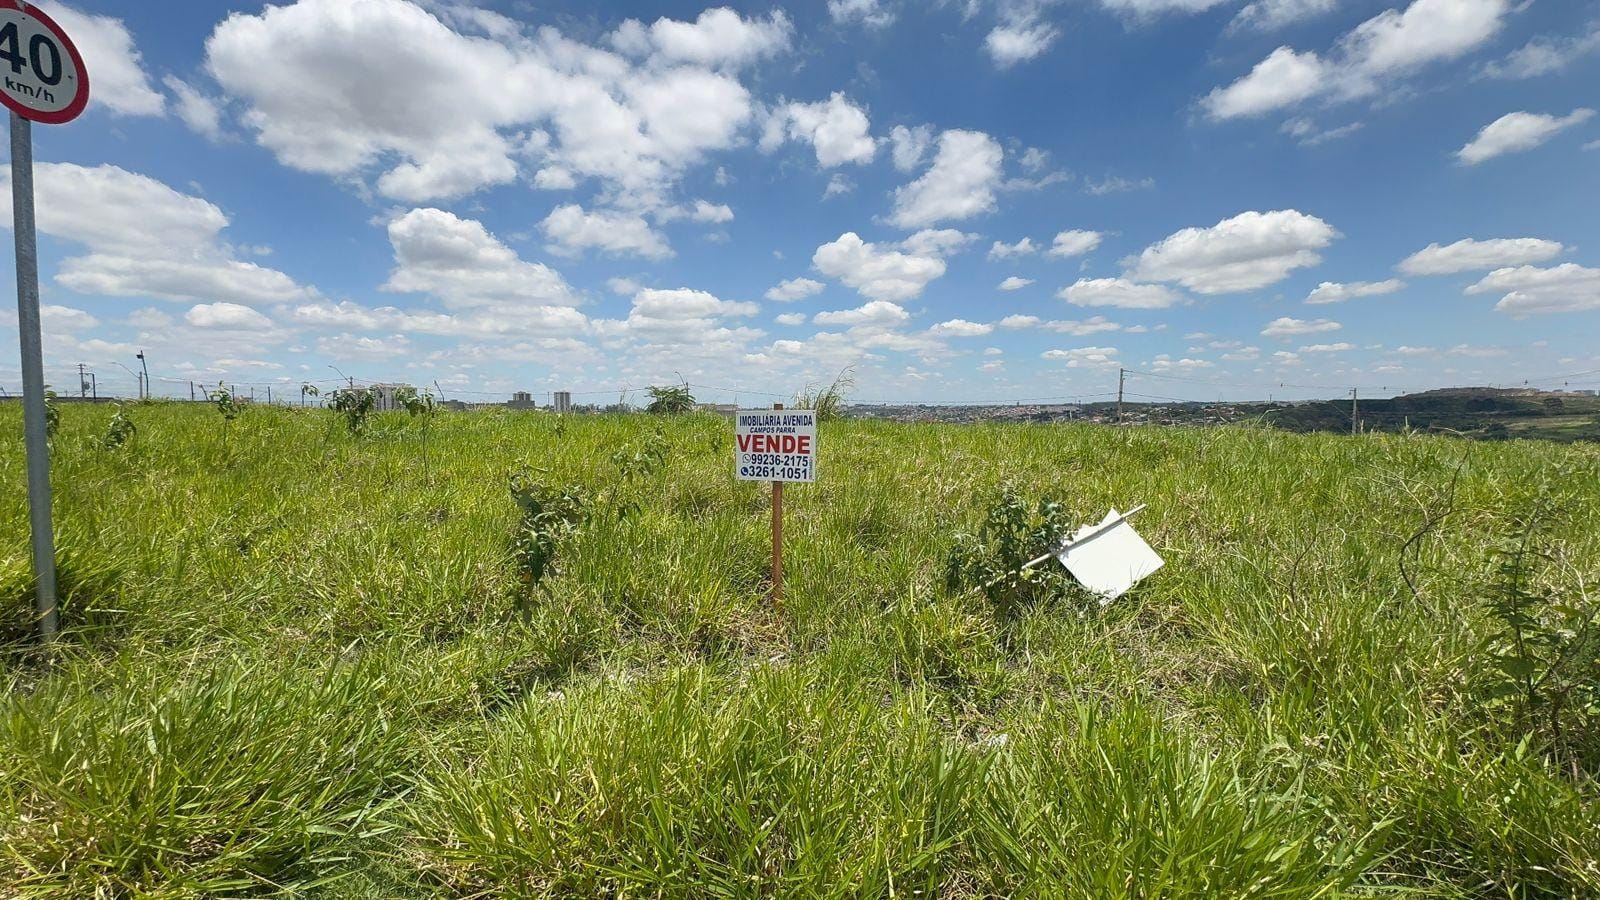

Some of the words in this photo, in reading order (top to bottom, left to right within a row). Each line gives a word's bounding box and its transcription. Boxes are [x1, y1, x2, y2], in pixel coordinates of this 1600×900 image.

[0, 21, 62, 86] 40
[5, 76, 55, 104] km/h
[739, 414, 781, 426] IMOBILIÁRIA
[783, 415, 813, 426] AVENIDA
[737, 434, 810, 454] VENDE
[751, 454, 808, 467] 99236-2175
[749, 466, 807, 479] 3261-1051
